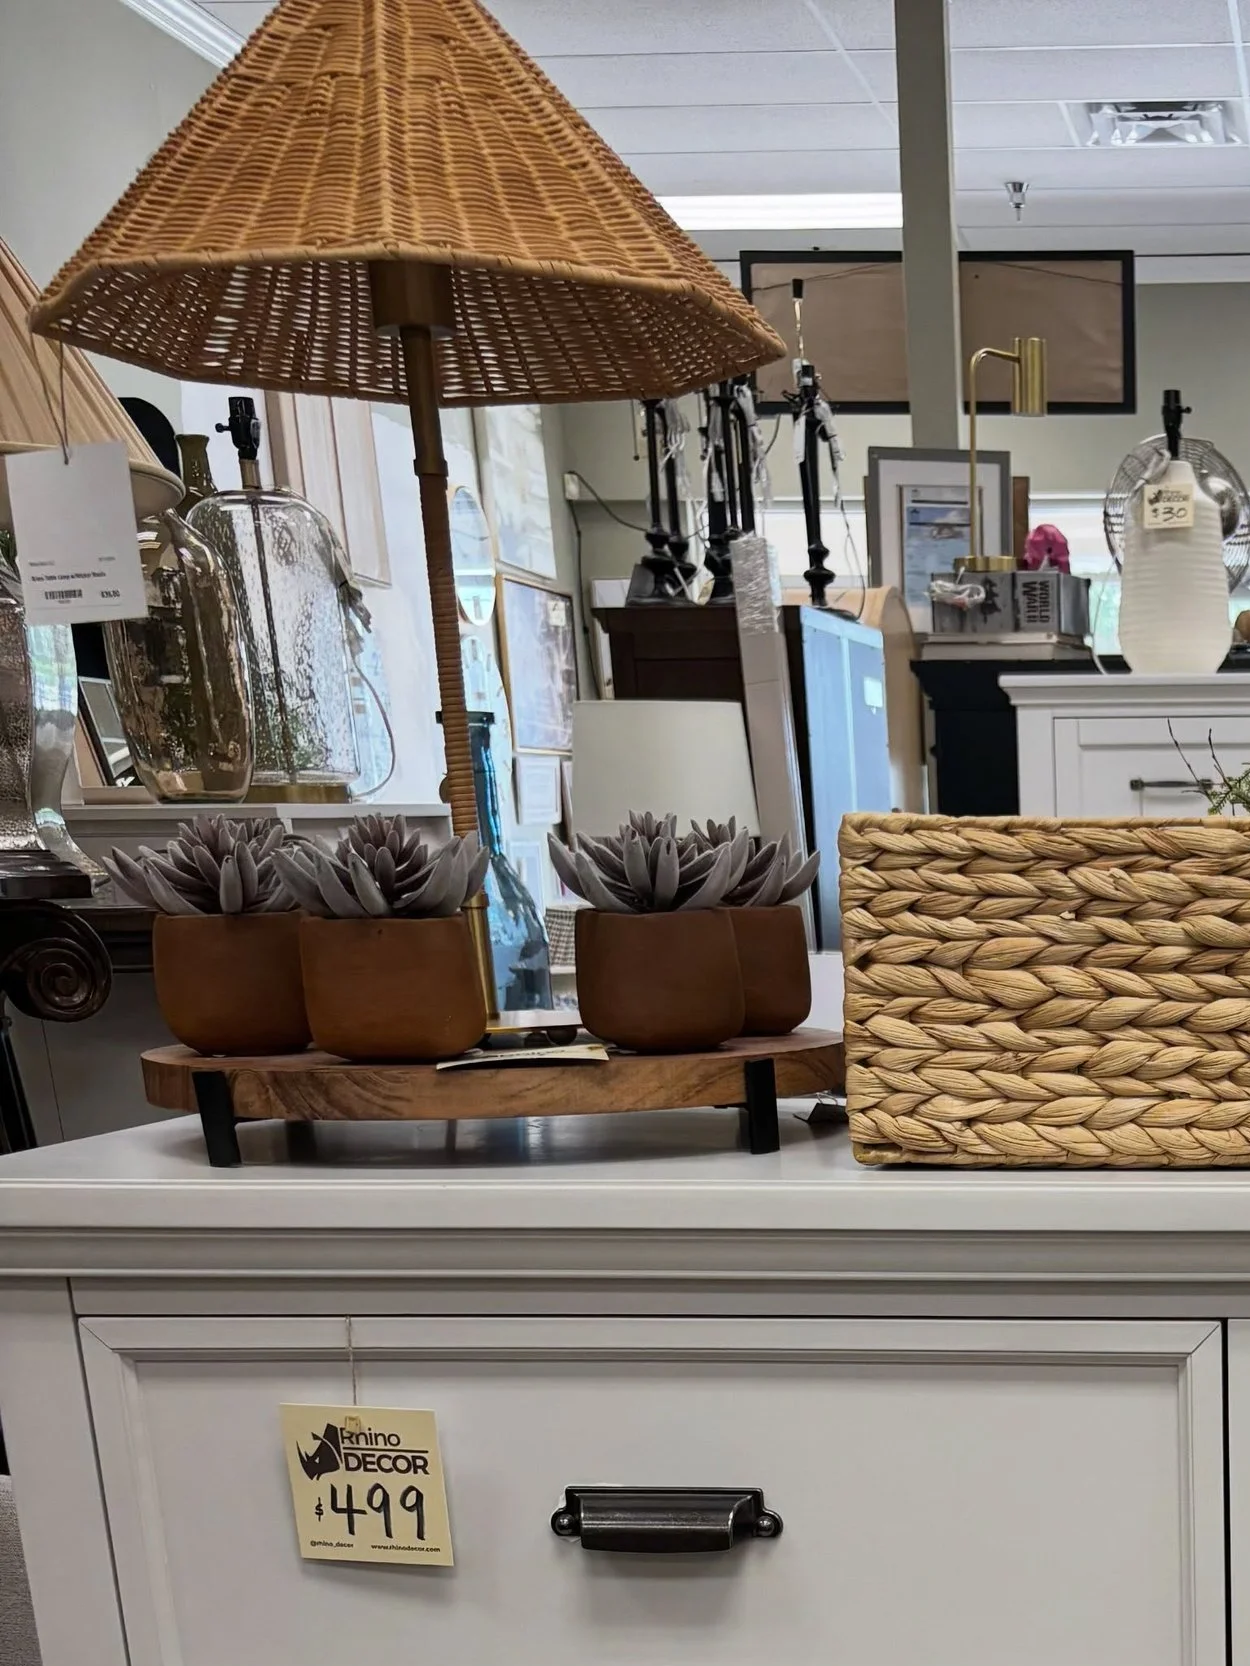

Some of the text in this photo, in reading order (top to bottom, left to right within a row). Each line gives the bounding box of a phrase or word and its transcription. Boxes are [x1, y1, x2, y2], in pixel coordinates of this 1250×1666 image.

[1151, 506, 1188, 522] $30
[1022, 581, 1038, 612] WAR
[1039, 580, 1050, 623] WORLD
[340, 1427, 400, 1447] Rhino
[343, 1453, 430, 1475] DECOR
[314, 1482, 426, 1541] $499
